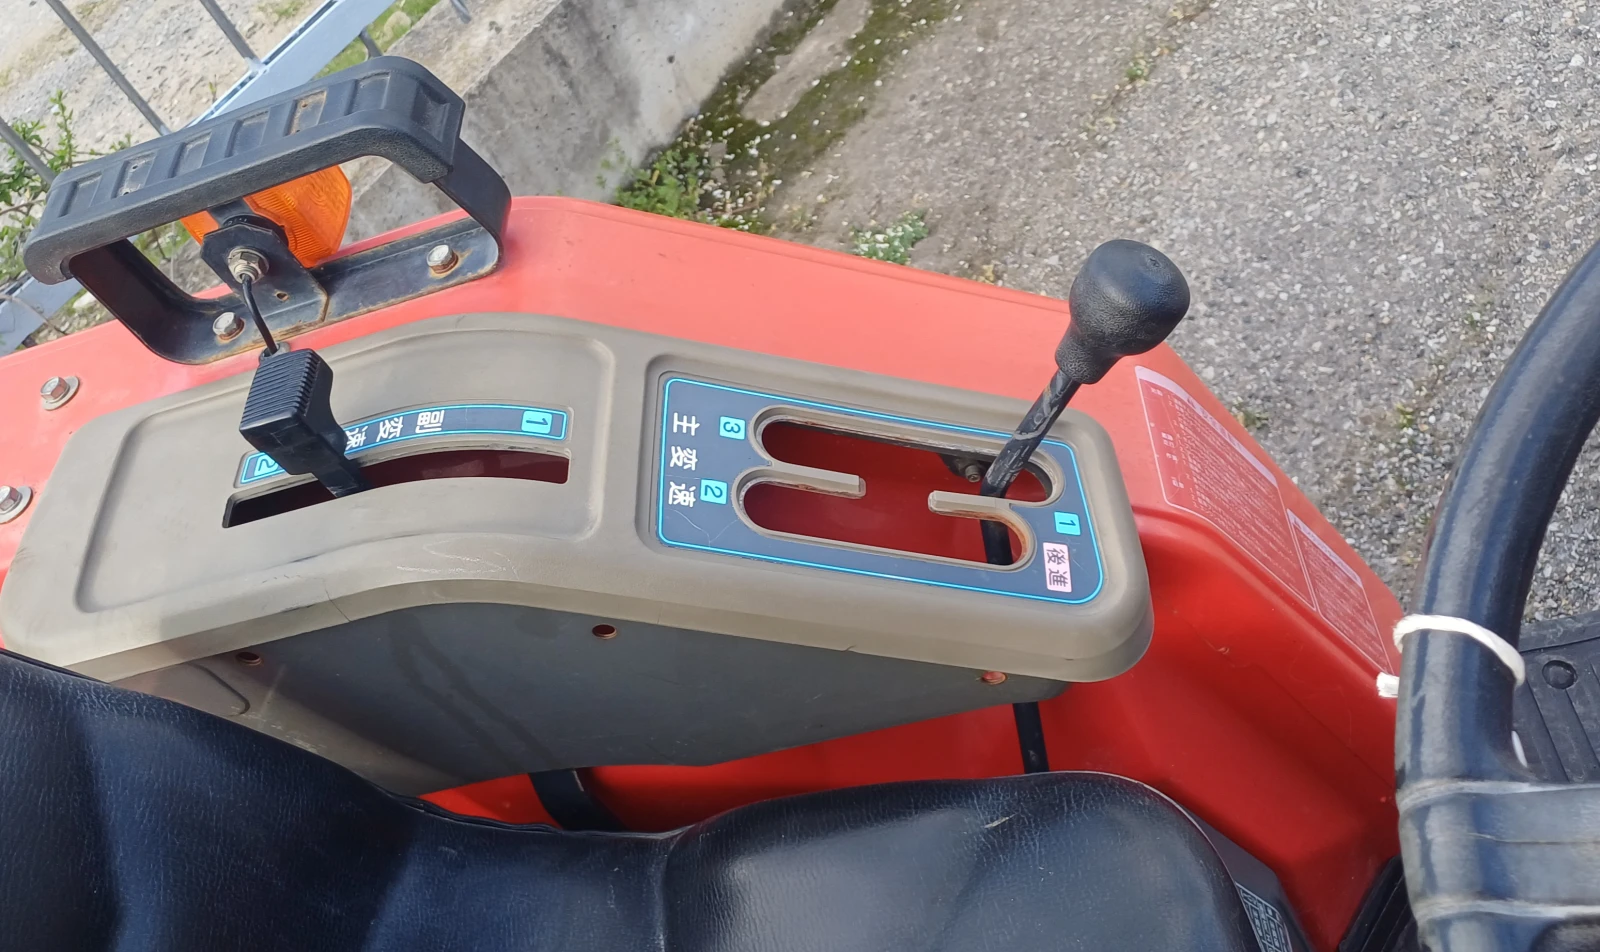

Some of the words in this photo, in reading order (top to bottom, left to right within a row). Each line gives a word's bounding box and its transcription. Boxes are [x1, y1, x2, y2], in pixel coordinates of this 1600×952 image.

[723, 421, 741, 434] 3
[669, 412, 700, 507] 主変速
[704, 484, 724, 498] 2
[1046, 548, 1068, 587] 後進
